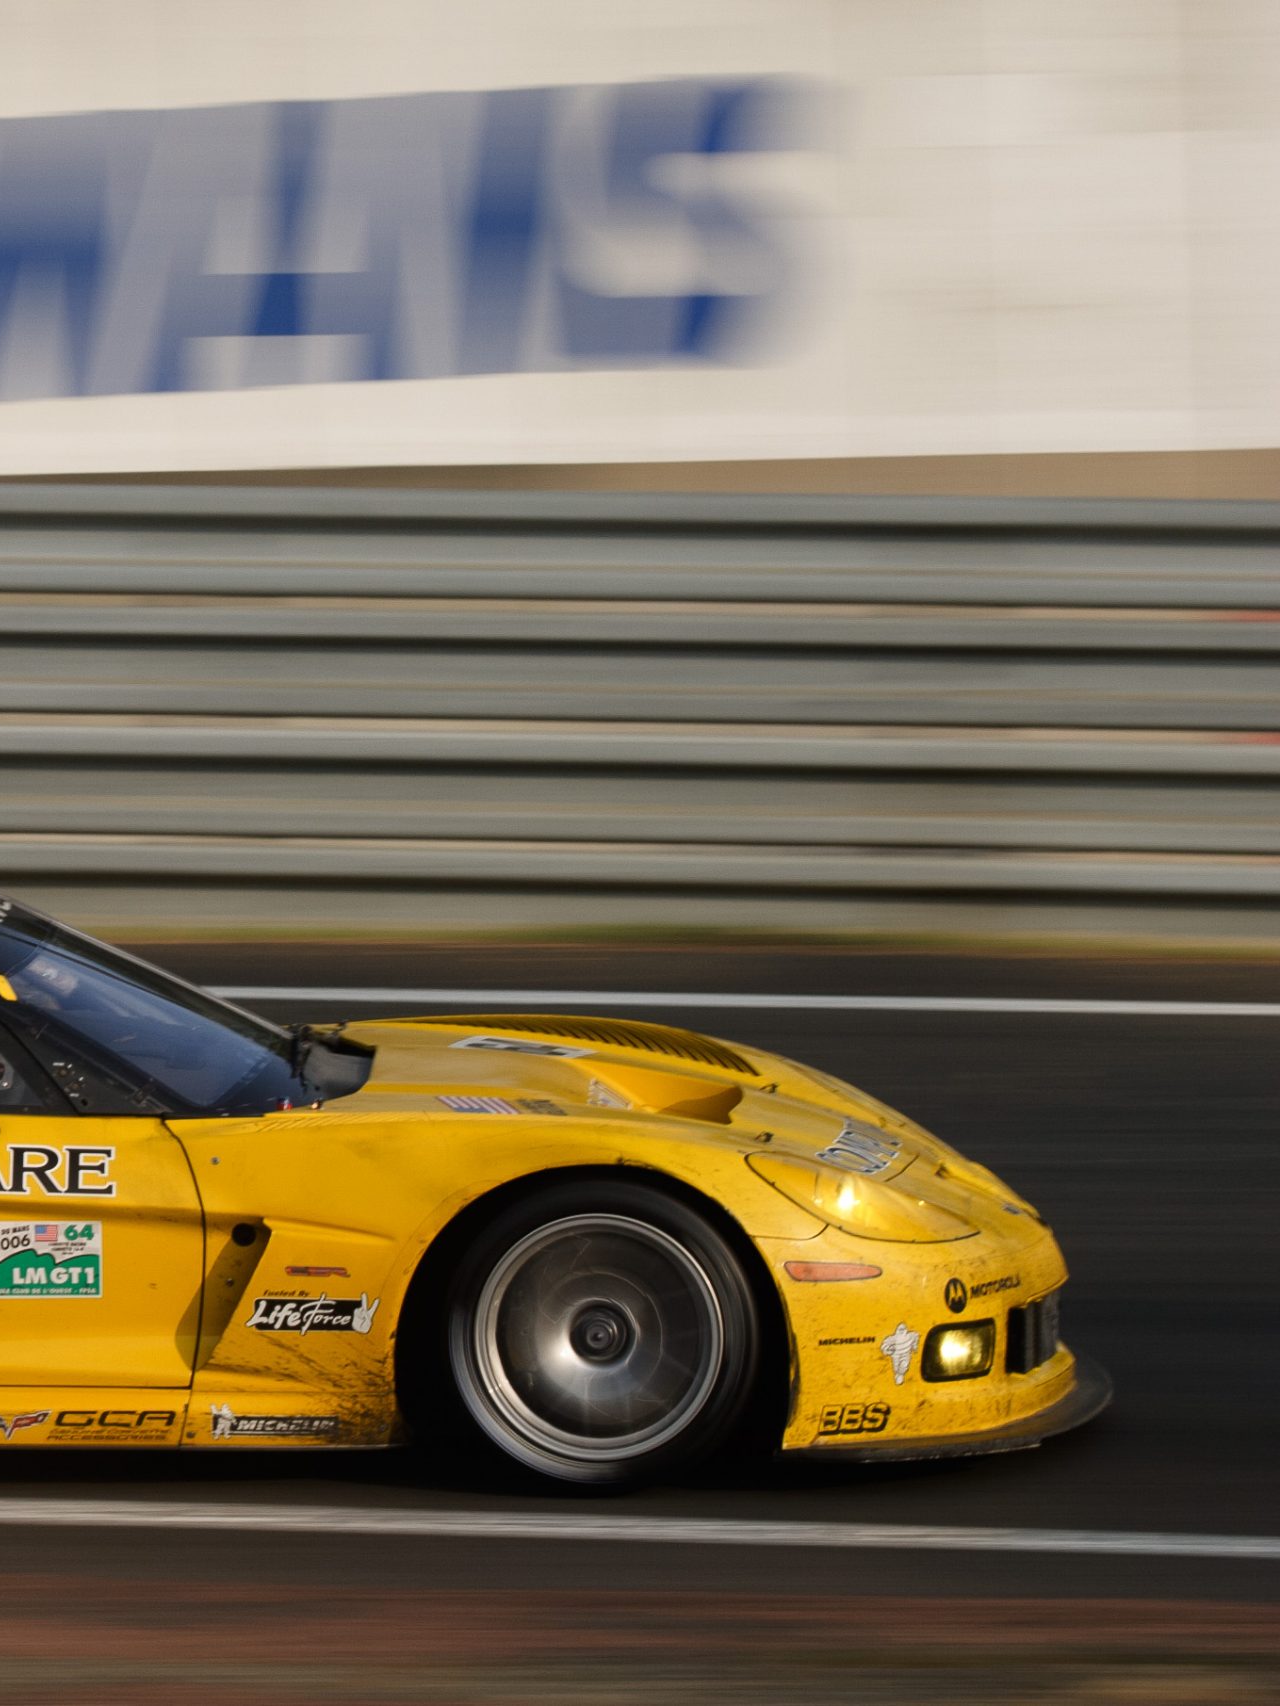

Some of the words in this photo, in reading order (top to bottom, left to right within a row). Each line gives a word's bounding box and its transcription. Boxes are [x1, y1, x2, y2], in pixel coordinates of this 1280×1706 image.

[64, 1224, 95, 1241] 64
[818, 1336, 876, 1346] MICHELIN
[55, 1410, 176, 1427] GCA
[818, 1402, 891, 1436] BBS
